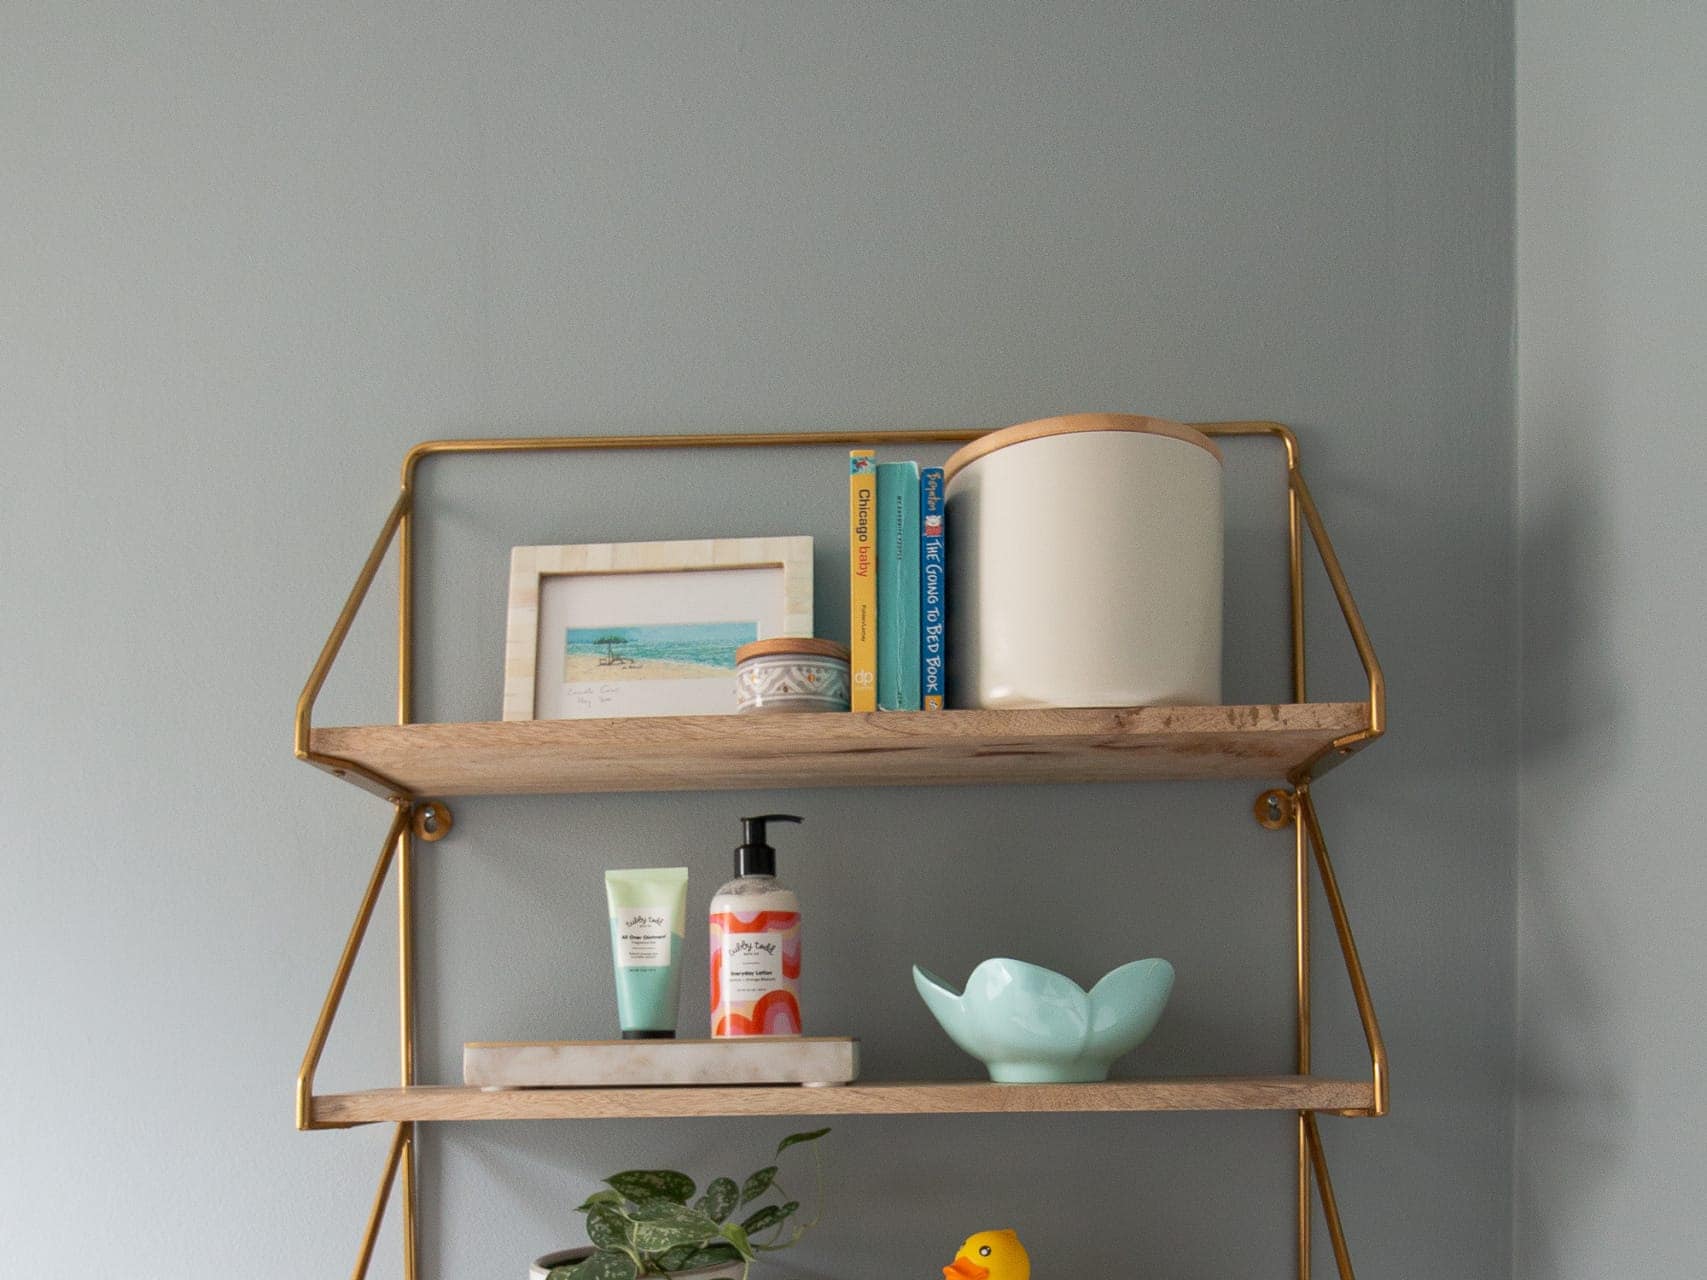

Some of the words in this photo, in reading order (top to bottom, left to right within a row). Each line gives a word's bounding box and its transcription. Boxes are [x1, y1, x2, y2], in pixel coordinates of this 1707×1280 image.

[857, 488, 871, 543] Chicago
[856, 545, 869, 578] baby
[925, 539, 941, 563] THE
[925, 564, 943, 604] GOING
[927, 607, 940, 623] TO
[925, 623, 942, 652] BED
[925, 656, 942, 692] BOOK
